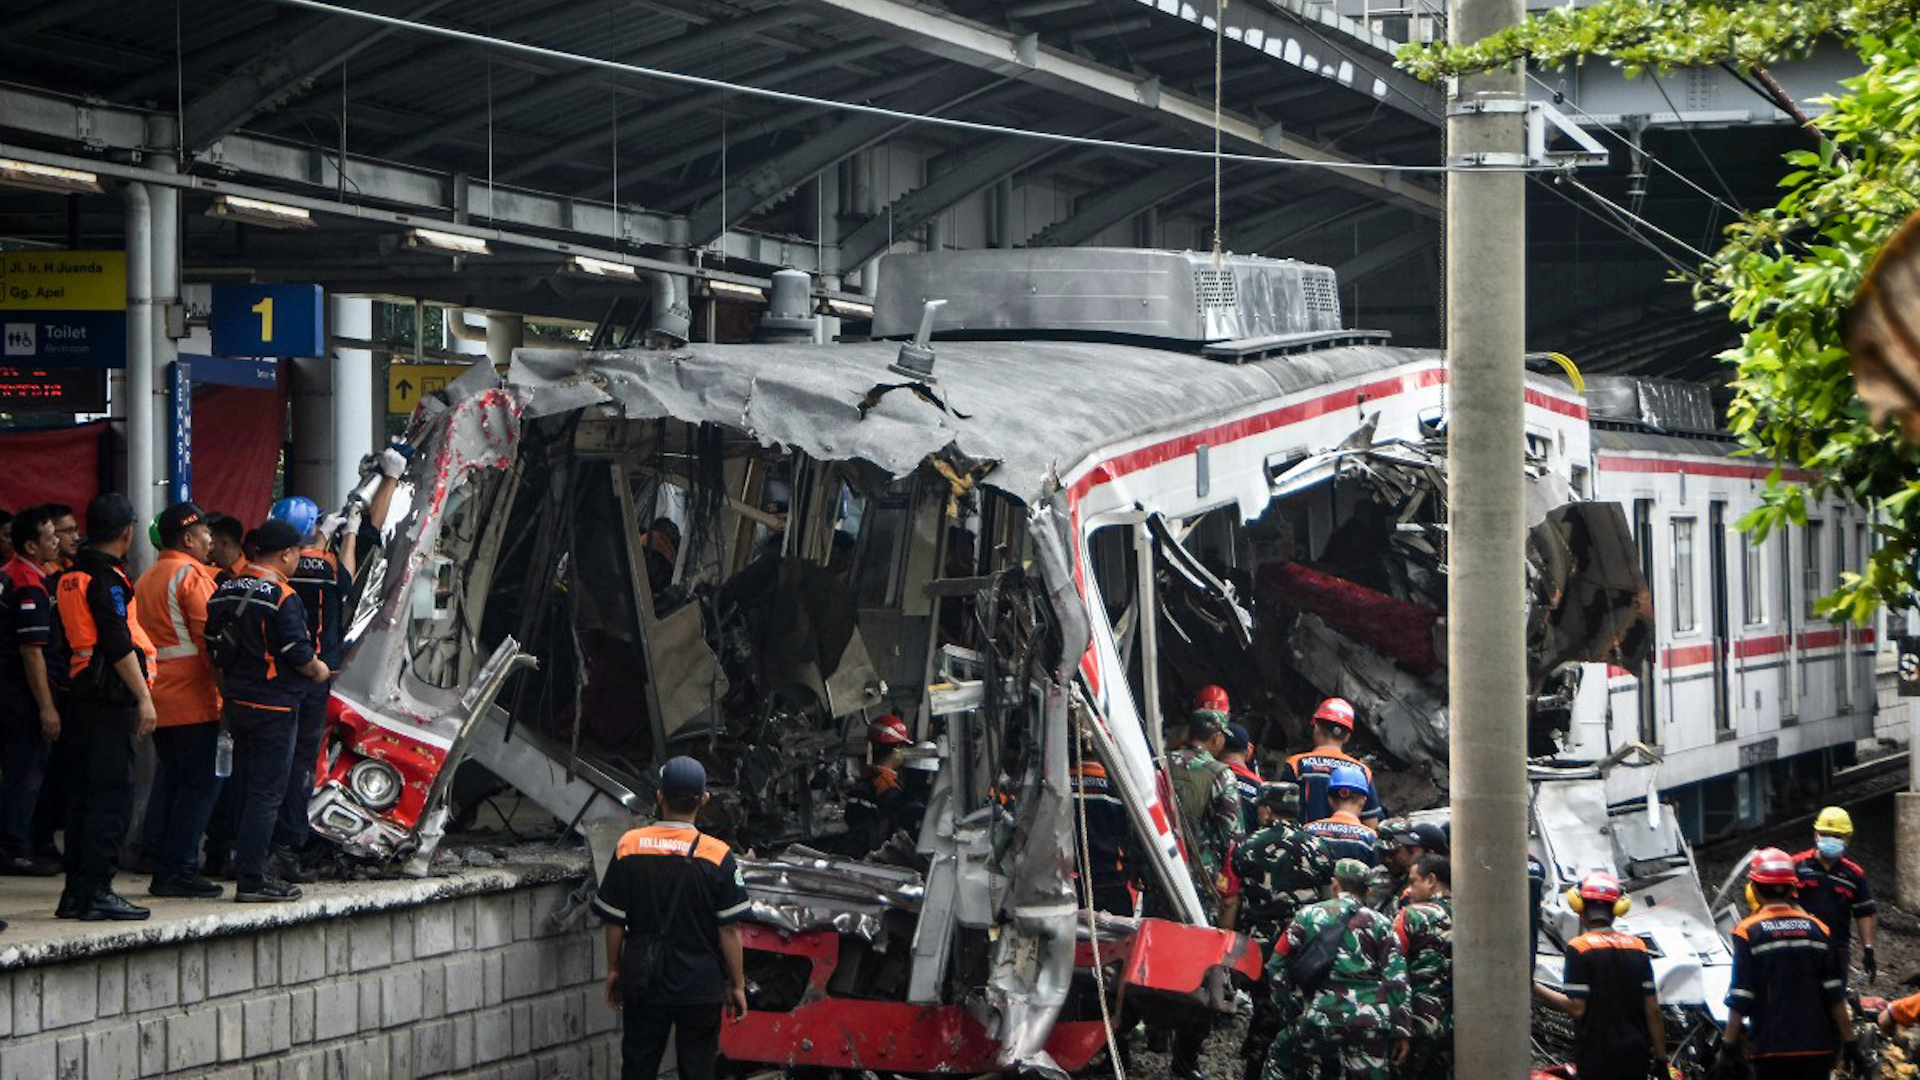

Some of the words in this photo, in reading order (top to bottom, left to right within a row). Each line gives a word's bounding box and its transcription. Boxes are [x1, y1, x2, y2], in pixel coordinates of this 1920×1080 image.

[44, 263, 54, 274] H
[57, 262, 103, 274] Juanda
[9, 286, 32, 300] Gg.
[36, 286, 65, 299] Apel
[251, 297, 274, 343] 1
[44, 325, 88, 340] Toilet
[44, 344, 91, 354] Restroom
[176, 369, 184, 474] BEKASI
[184, 378, 192, 465] TIMUR
[639, 836, 697, 854] ROLLINGSTOC
[1760, 919, 1813, 932] ROLLINGSTOCK
